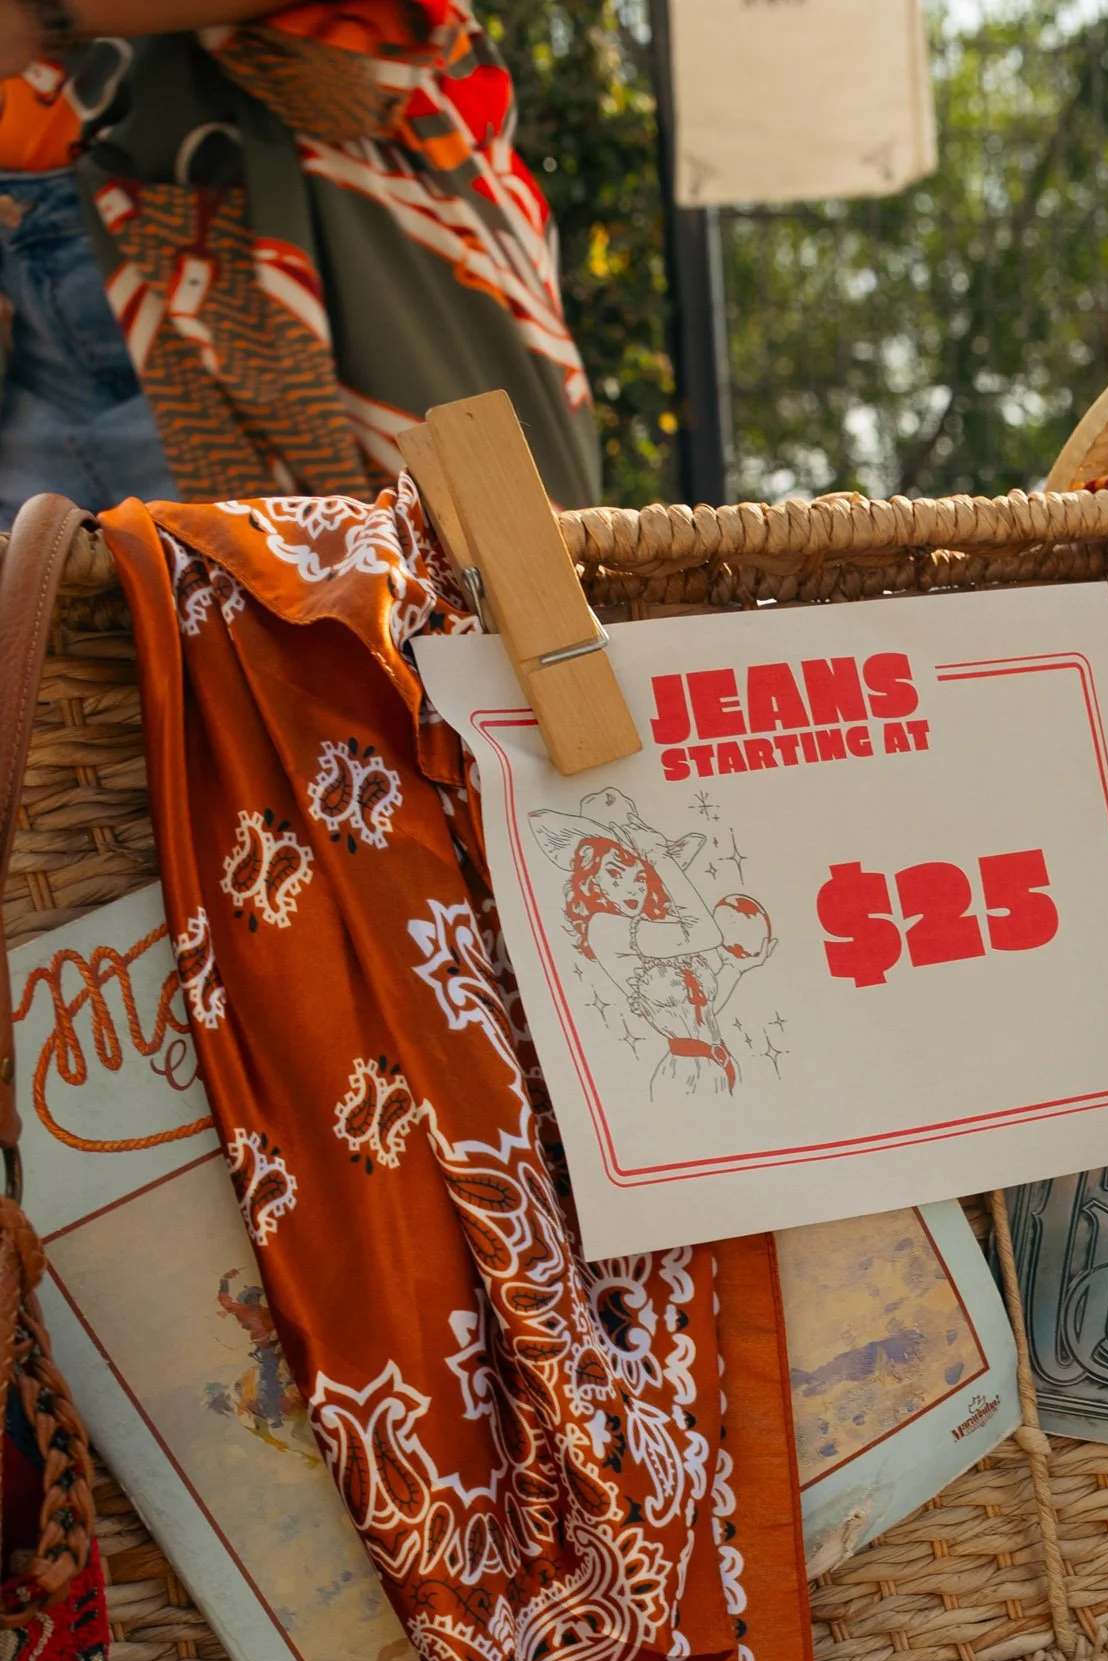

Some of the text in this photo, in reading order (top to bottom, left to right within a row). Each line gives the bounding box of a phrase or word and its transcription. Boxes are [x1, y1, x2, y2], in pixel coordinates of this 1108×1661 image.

[649, 652, 921, 746] JEANS
[659, 719, 931, 782] STARTING AT
[816, 848, 1060, 988] $25
